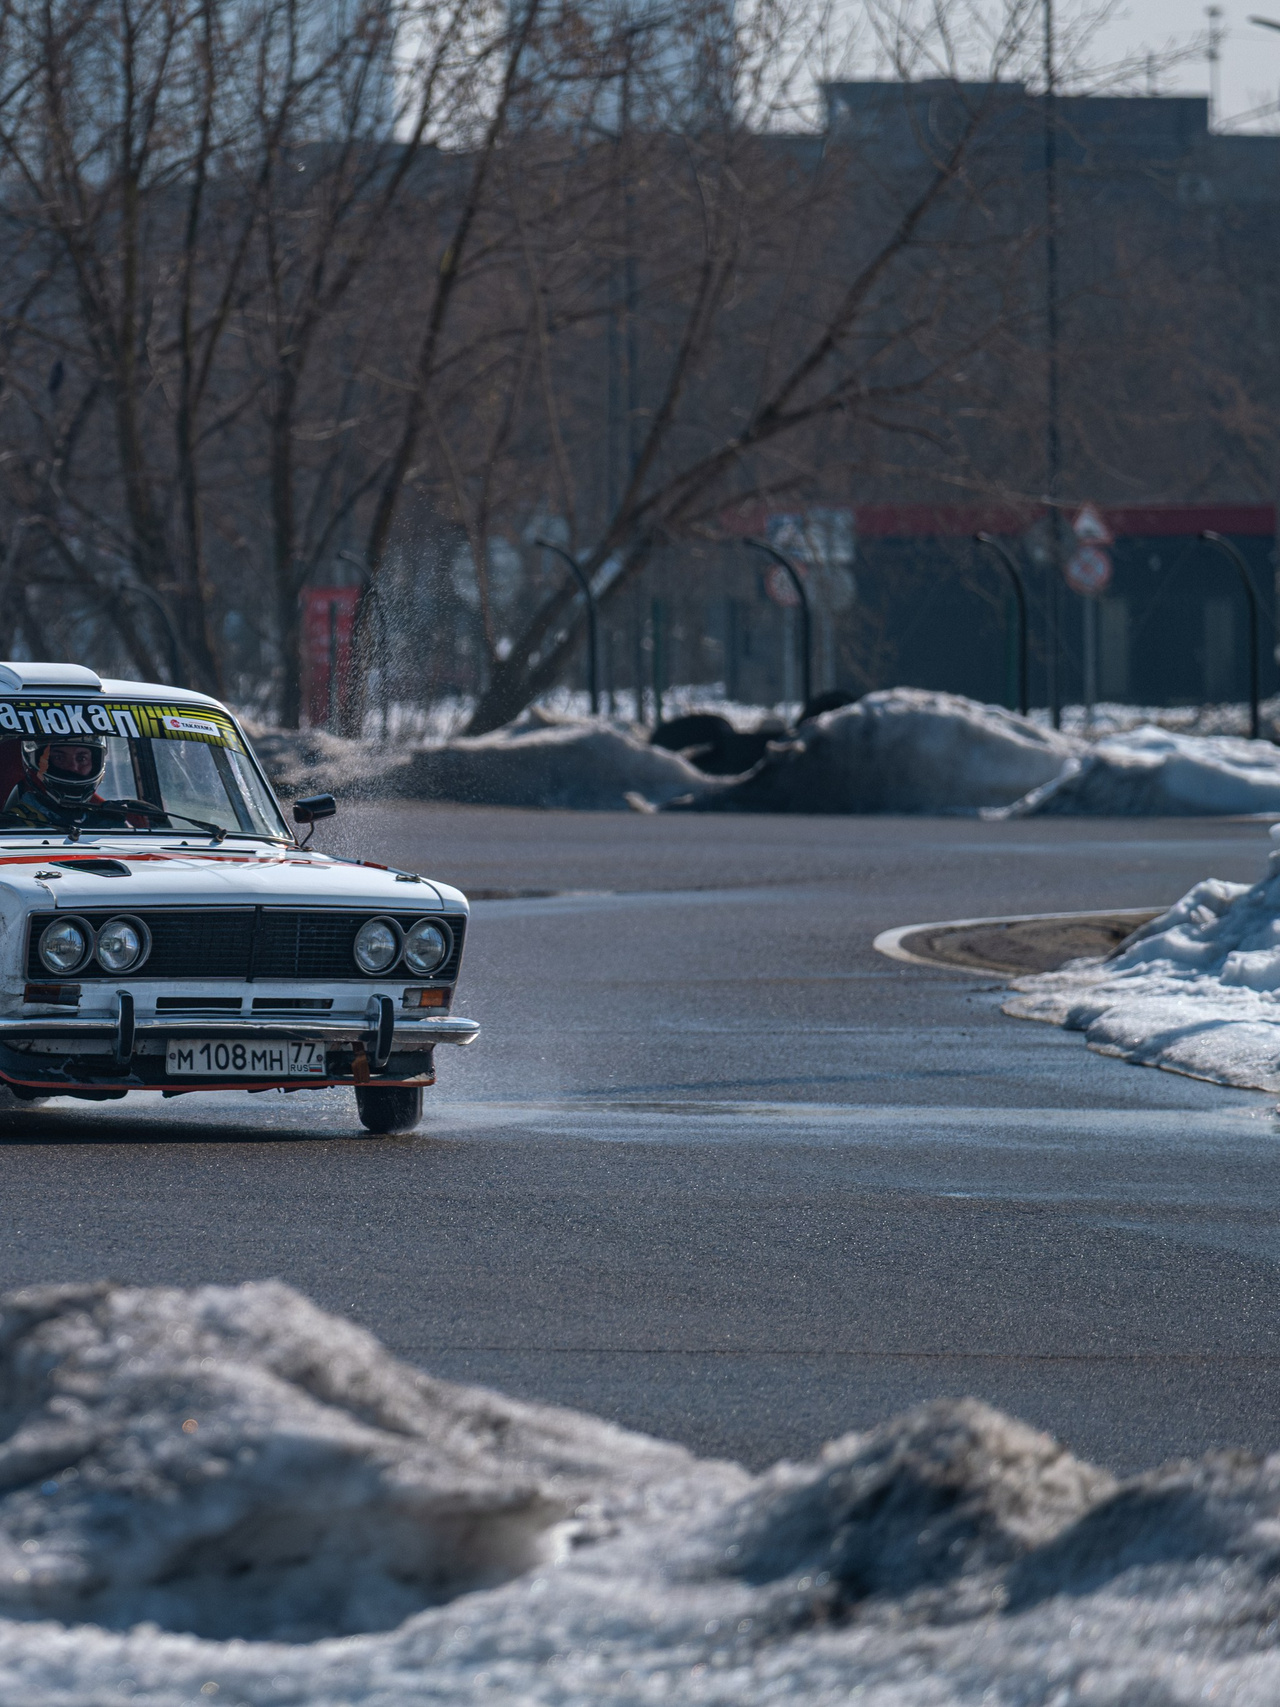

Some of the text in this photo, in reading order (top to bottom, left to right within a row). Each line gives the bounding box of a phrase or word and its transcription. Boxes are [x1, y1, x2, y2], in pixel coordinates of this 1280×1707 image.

[181, 722, 215, 732] TAKAYAMA
[199, 1043, 247, 1070] 108
[291, 1042, 316, 1063] 77
[290, 1064, 309, 1072] RUS
